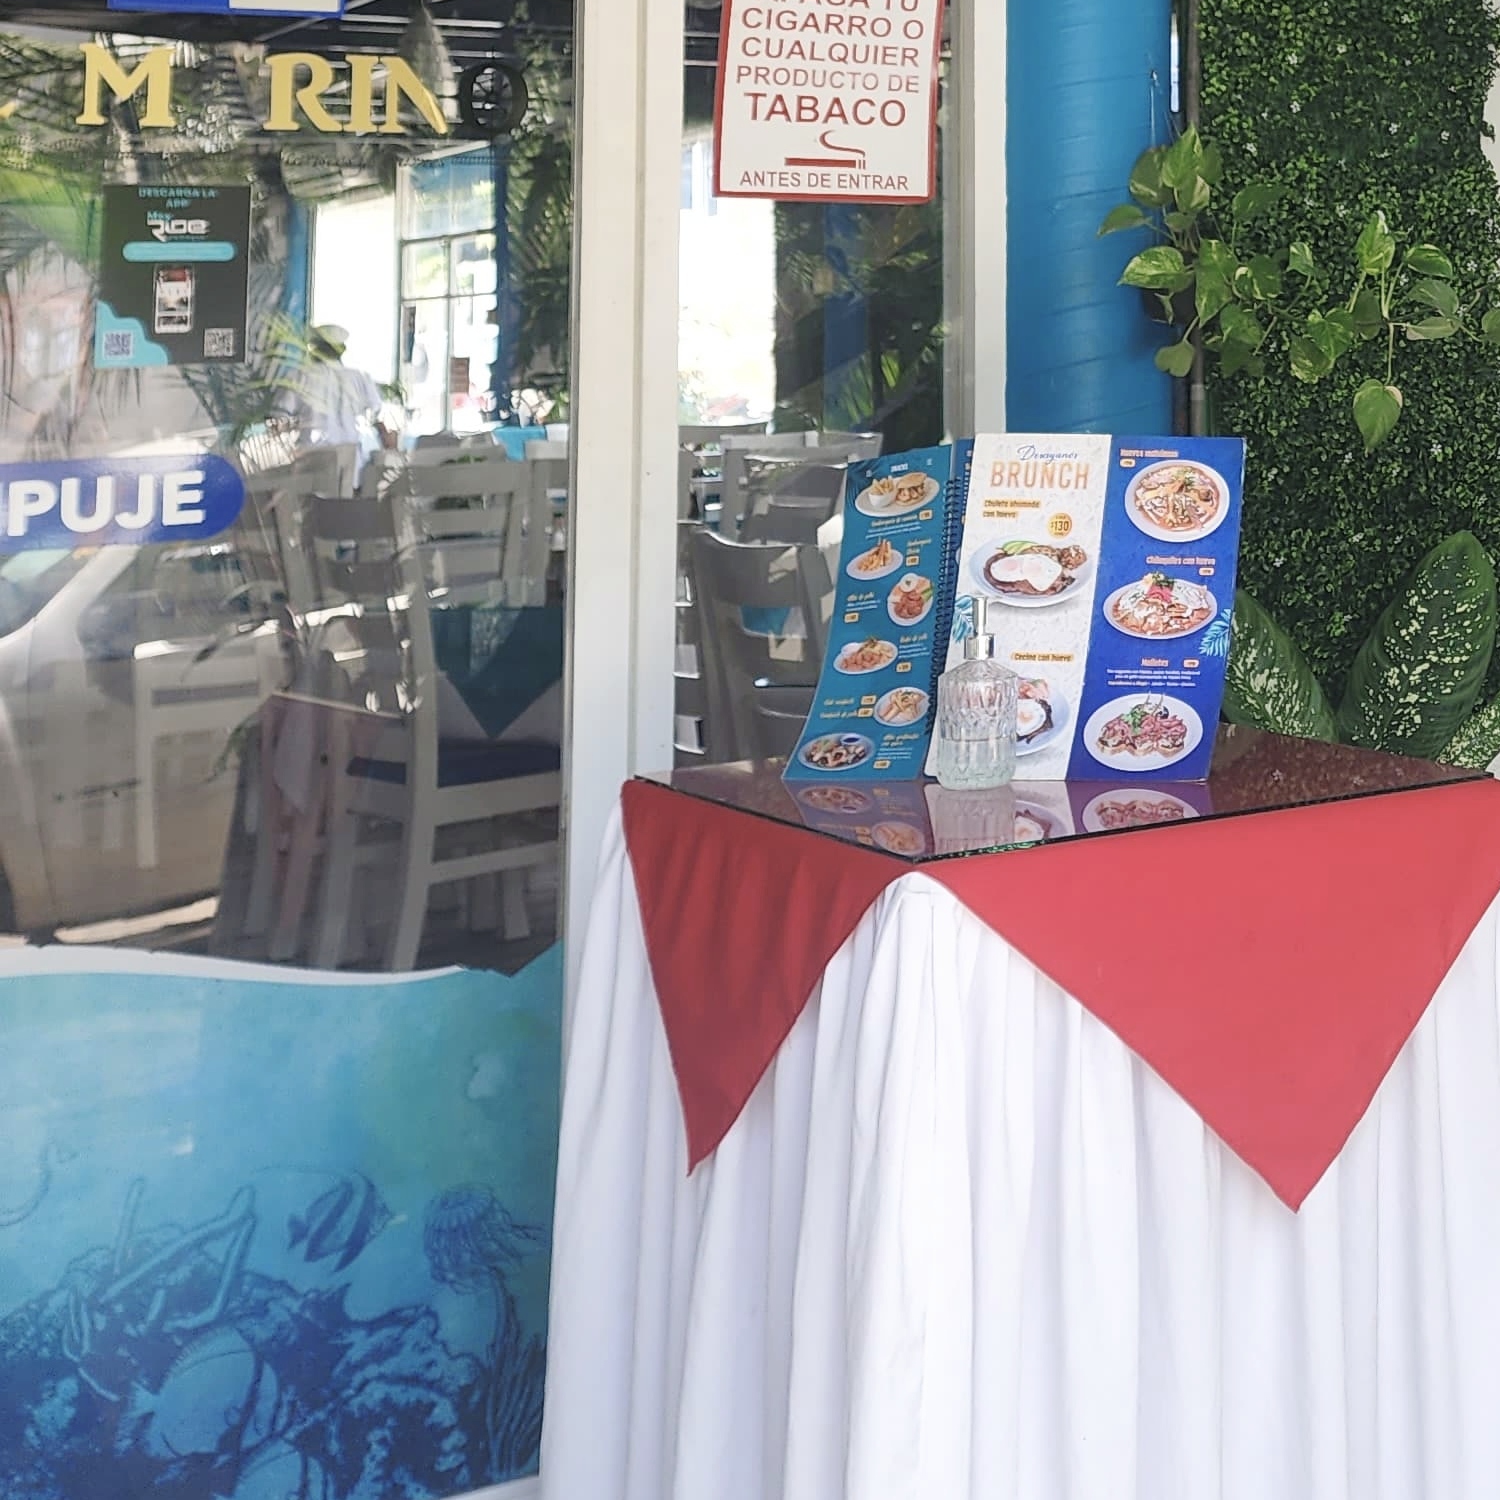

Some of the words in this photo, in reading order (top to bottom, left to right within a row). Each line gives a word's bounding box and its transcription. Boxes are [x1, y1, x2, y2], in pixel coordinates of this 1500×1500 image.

[741, 7, 892, 38] CIGARRO
[903, 19, 924, 40] O
[741, 36, 919, 67] CUALQUIER
[736, 65, 879, 92] PRODUCTO
[888, 75, 919, 93] DE
[743, 92, 906, 127] TABACO
[740, 171, 800, 188] ANTES
[807, 172, 831, 189] DE
[837, 173, 909, 191] ENTRAR
[990, 461, 1090, 490] BRUNCH
[0, 469, 206, 537] PUJE
